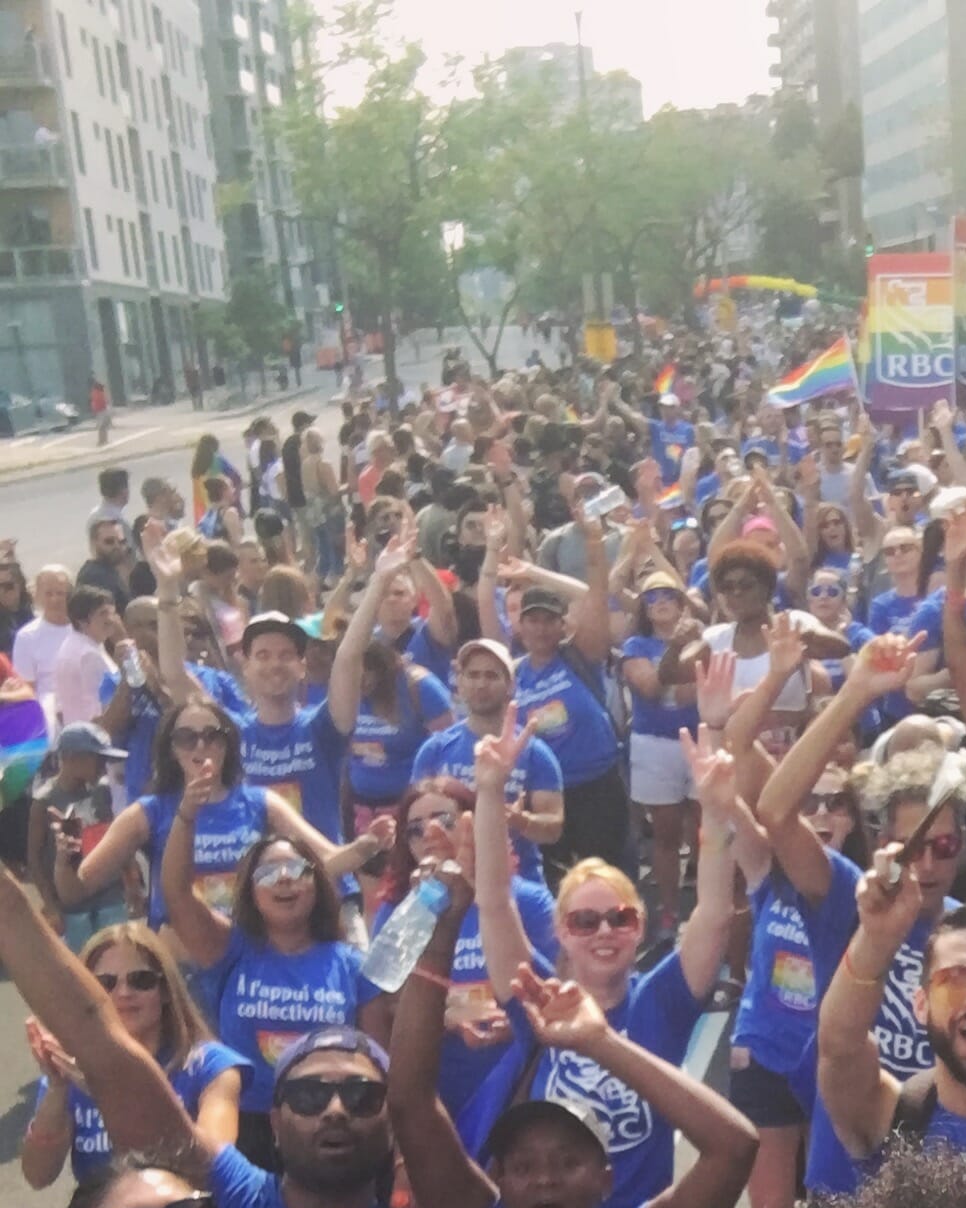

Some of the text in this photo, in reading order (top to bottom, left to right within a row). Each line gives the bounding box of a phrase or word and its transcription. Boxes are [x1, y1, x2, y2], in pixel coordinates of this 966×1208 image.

[887, 353, 954, 378] RBC
[250, 980, 310, 1002] l'appui
[237, 1001, 346, 1025] collectivités
[874, 1025, 932, 1066] RBC
